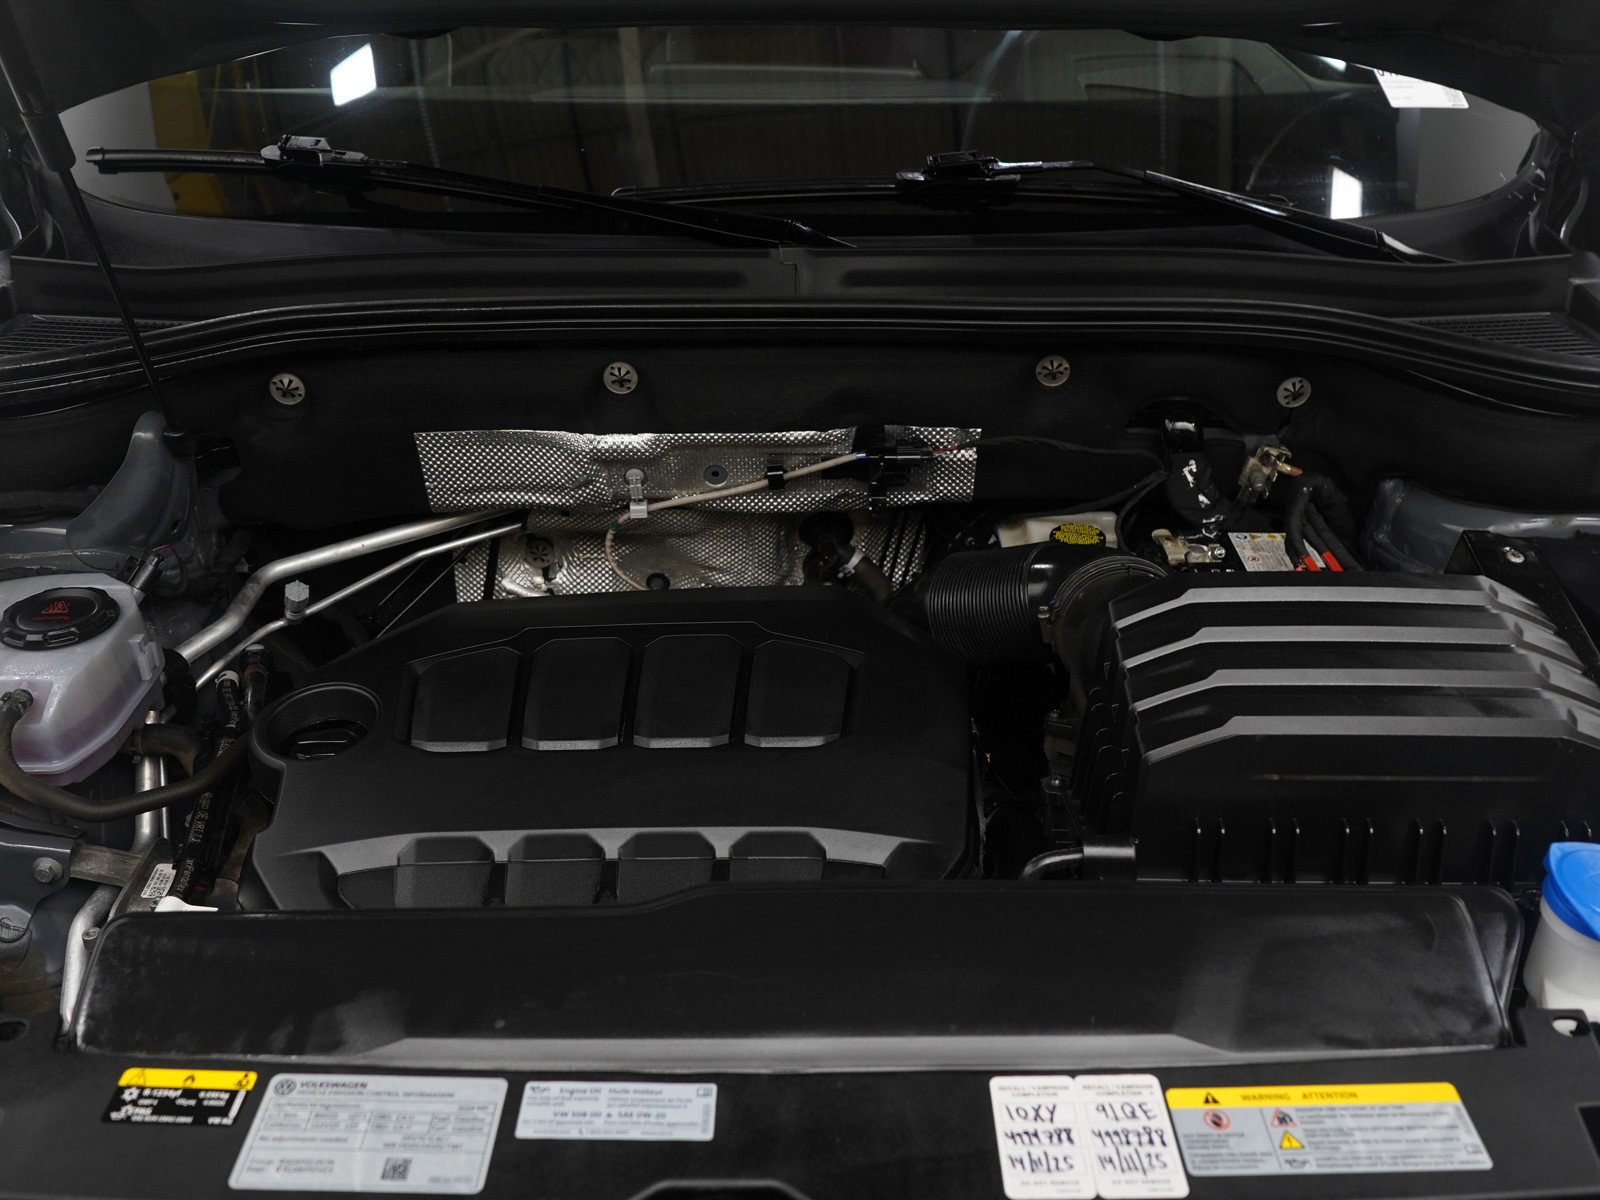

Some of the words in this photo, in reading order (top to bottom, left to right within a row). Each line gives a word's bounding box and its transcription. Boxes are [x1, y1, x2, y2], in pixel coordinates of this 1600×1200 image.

[300, 1081, 368, 1089] VOLKSWAGEN
[560, 1088, 587, 1096] Engine
[1240, 1092, 1290, 1101] WARNING
[1302, 1091, 1358, 1100] ATTENTION
